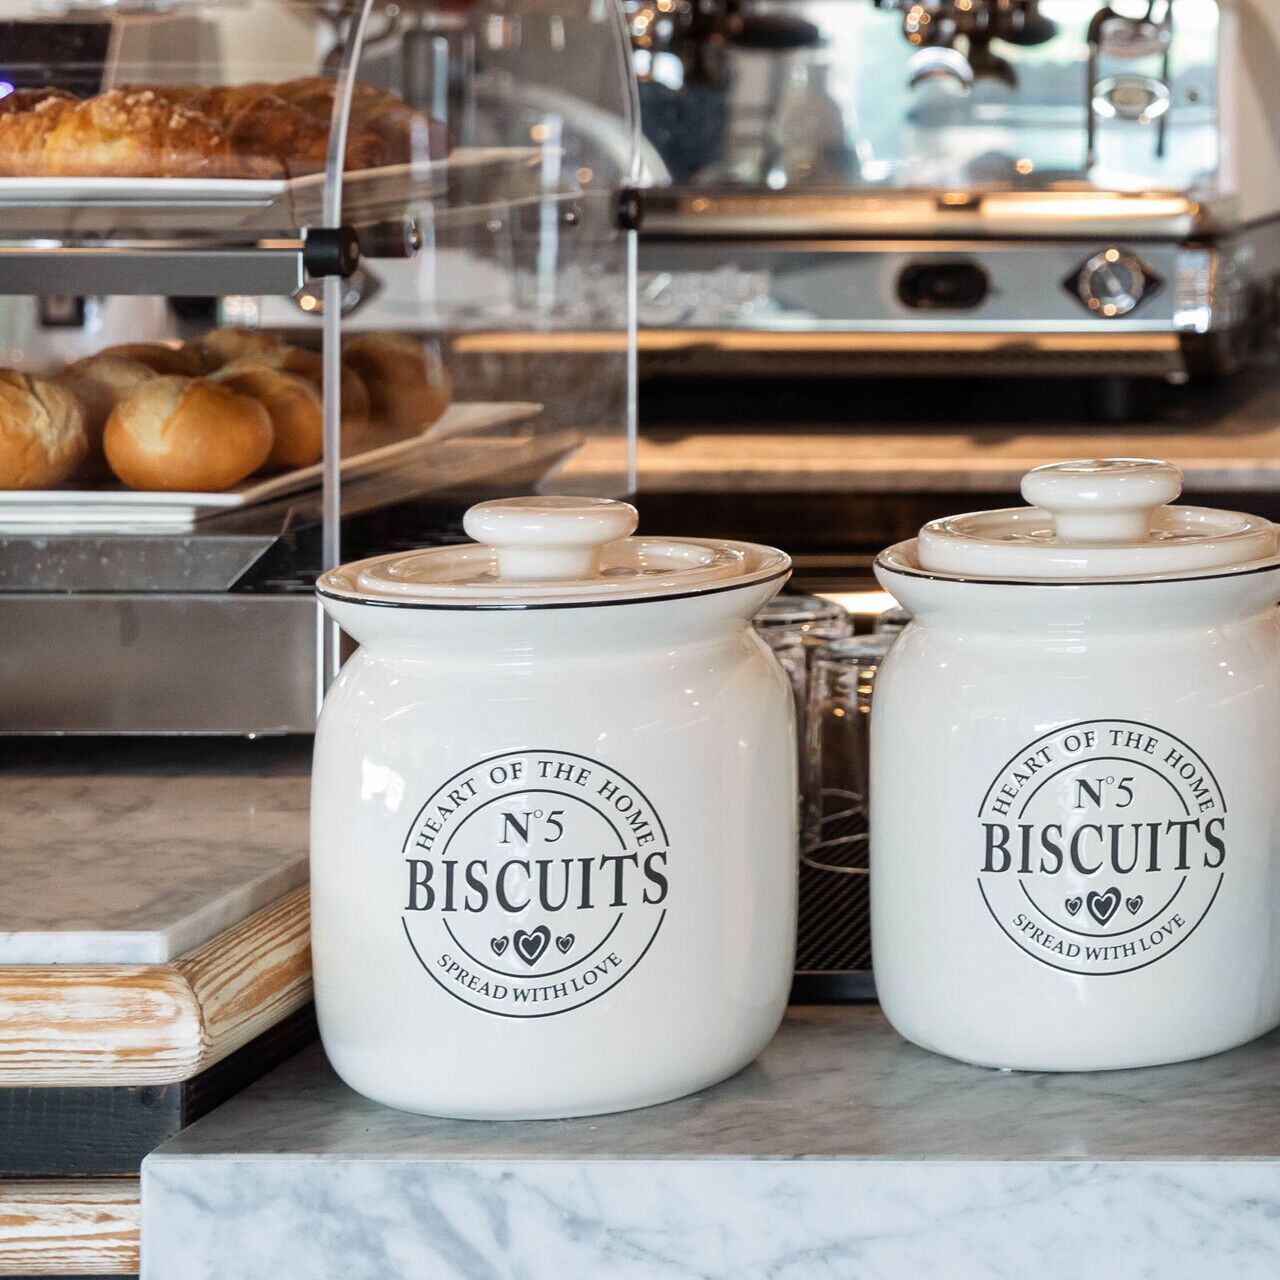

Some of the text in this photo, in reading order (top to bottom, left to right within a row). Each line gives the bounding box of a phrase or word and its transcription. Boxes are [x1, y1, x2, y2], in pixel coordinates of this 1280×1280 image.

[992, 730, 1216, 816] HEART OF THE HOME
[415, 760, 656, 851] HEART OF THE HOME
[980, 817, 1226, 875] BISCUITS
[404, 851, 670, 914] BISCUITS
[1012, 913, 1187, 961] SPREAD WITH LOVE
[437, 952, 623, 1003] SPREAD WITH LOVE
